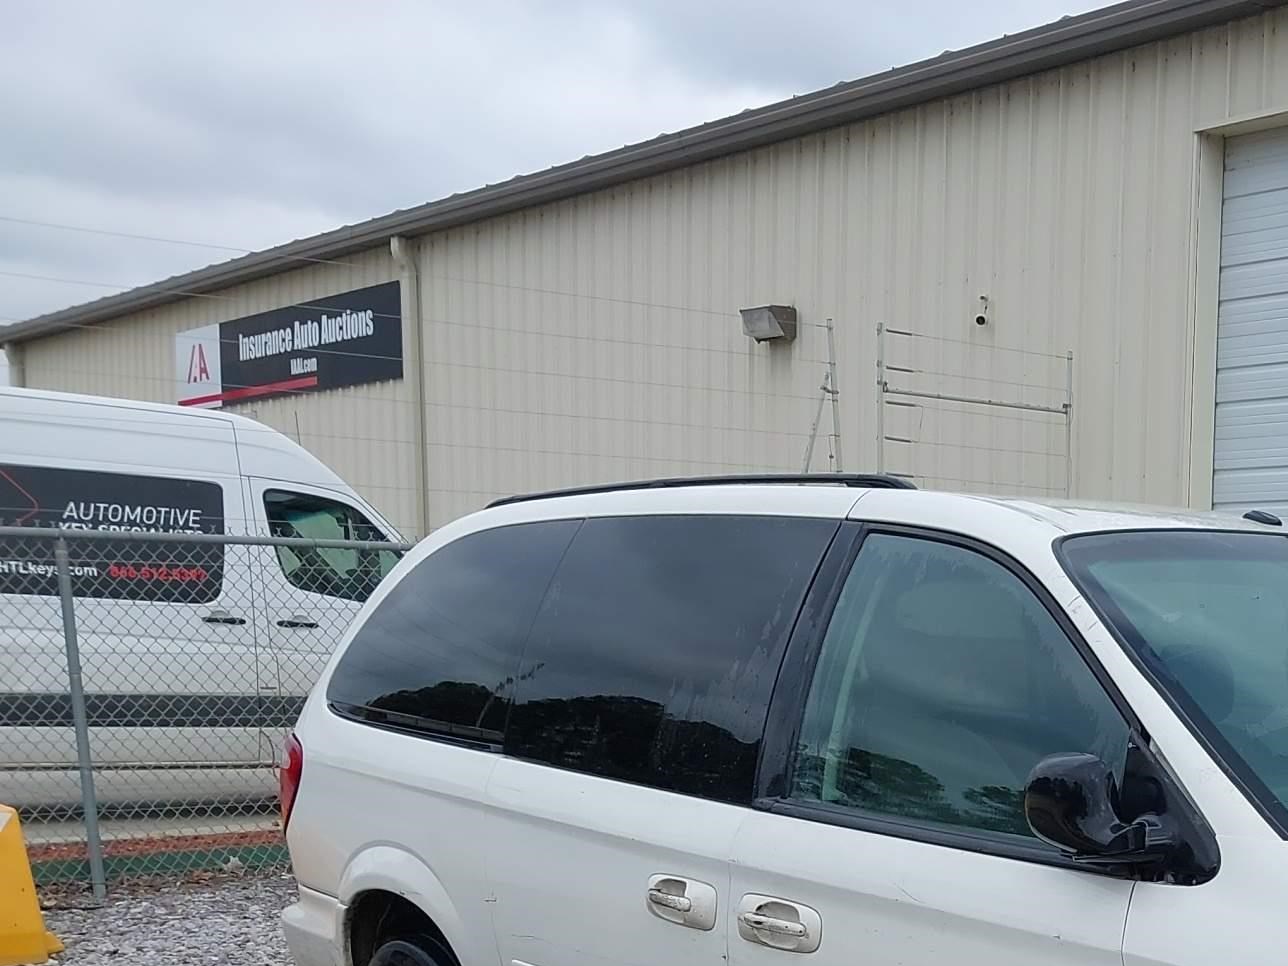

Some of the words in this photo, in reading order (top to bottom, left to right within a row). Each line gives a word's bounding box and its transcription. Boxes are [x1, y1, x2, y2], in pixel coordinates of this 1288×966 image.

[239, 327, 292, 361] Insurance
[294, 321, 319, 350] Auto
[321, 309, 374, 345] Auctions
[62, 501, 202, 527] AUTOMOTIVE
